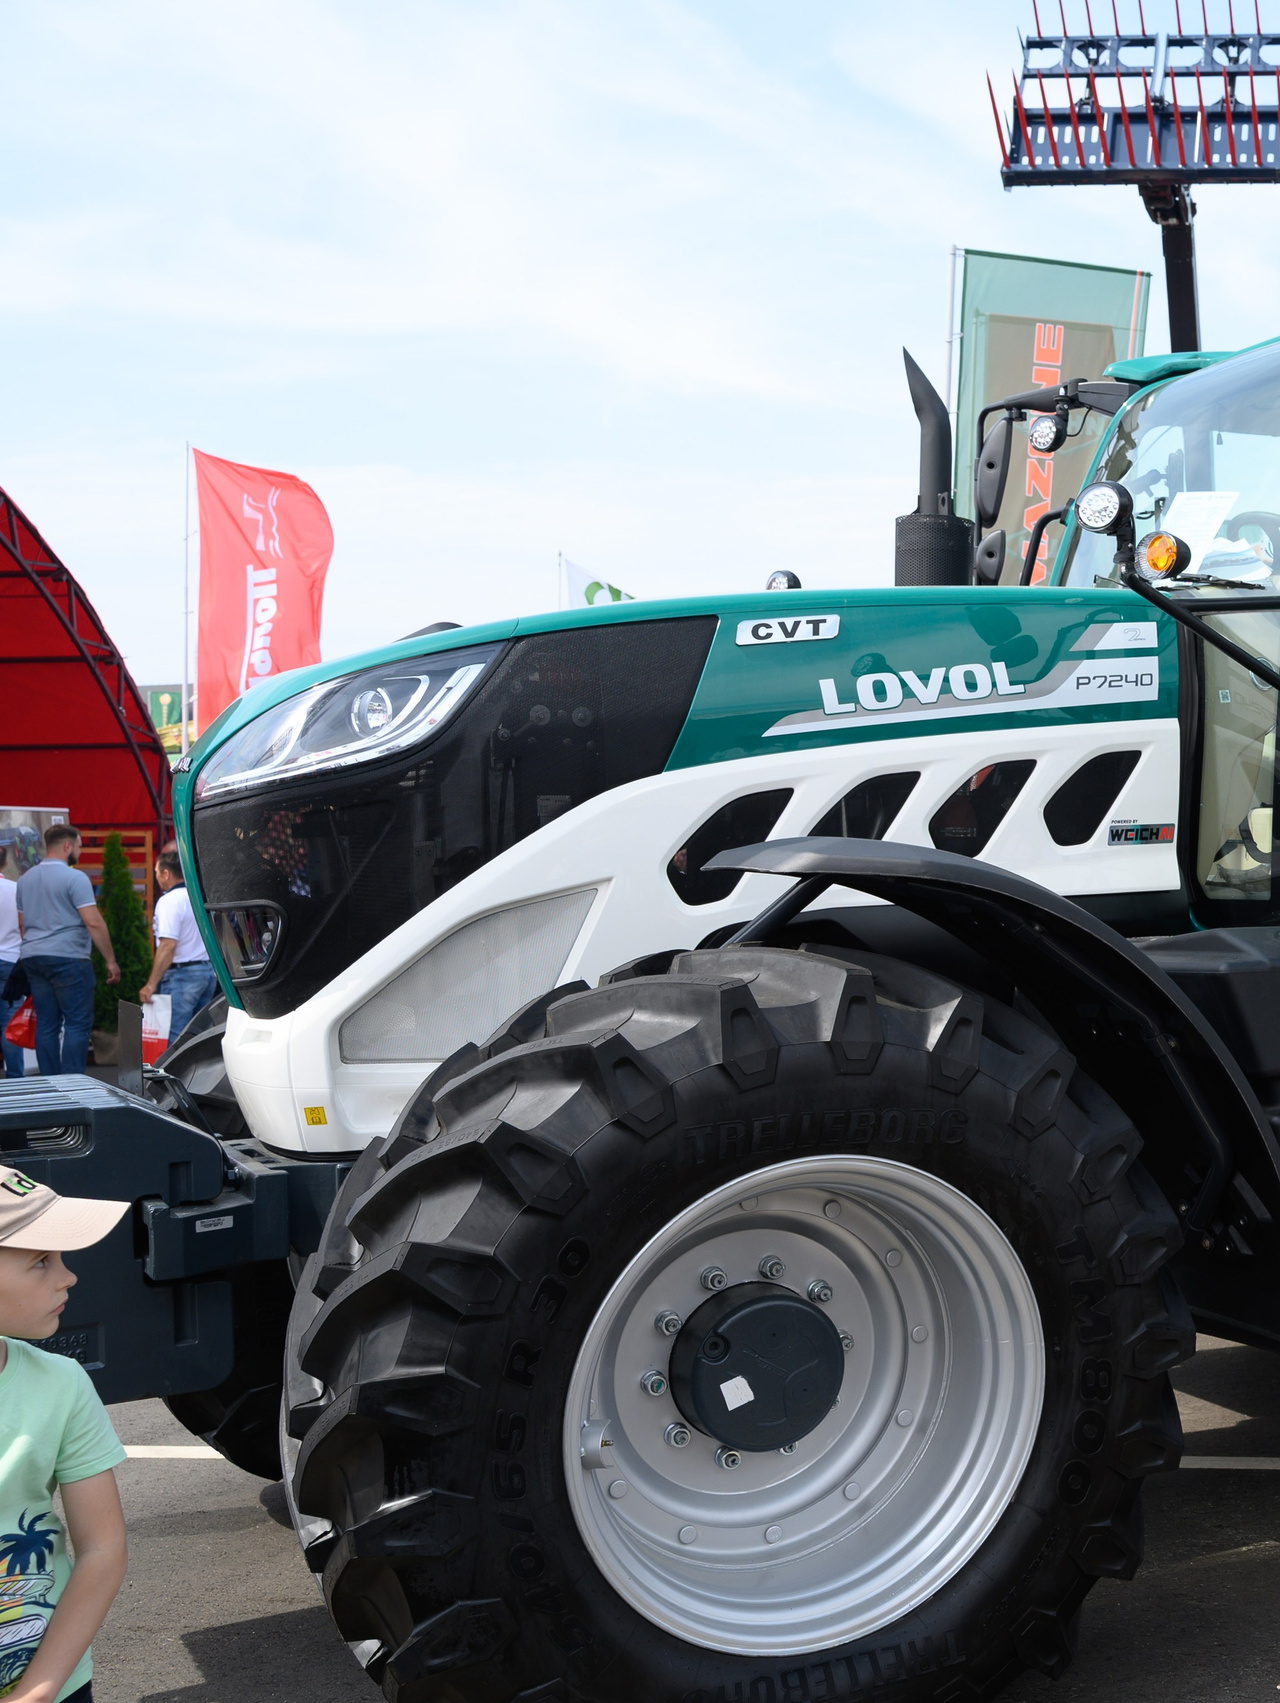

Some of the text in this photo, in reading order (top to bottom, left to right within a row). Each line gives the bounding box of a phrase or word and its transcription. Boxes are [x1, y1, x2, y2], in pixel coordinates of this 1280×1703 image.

[751, 618, 828, 641] CVT
[819, 660, 1026, 715] LOVOL
[1076, 672, 1153, 691] P7240
[1110, 826, 1174, 842] WEICHAI
[683, 1107, 970, 1166] TRELLEBORG
[530, 1234, 593, 1326] 30
